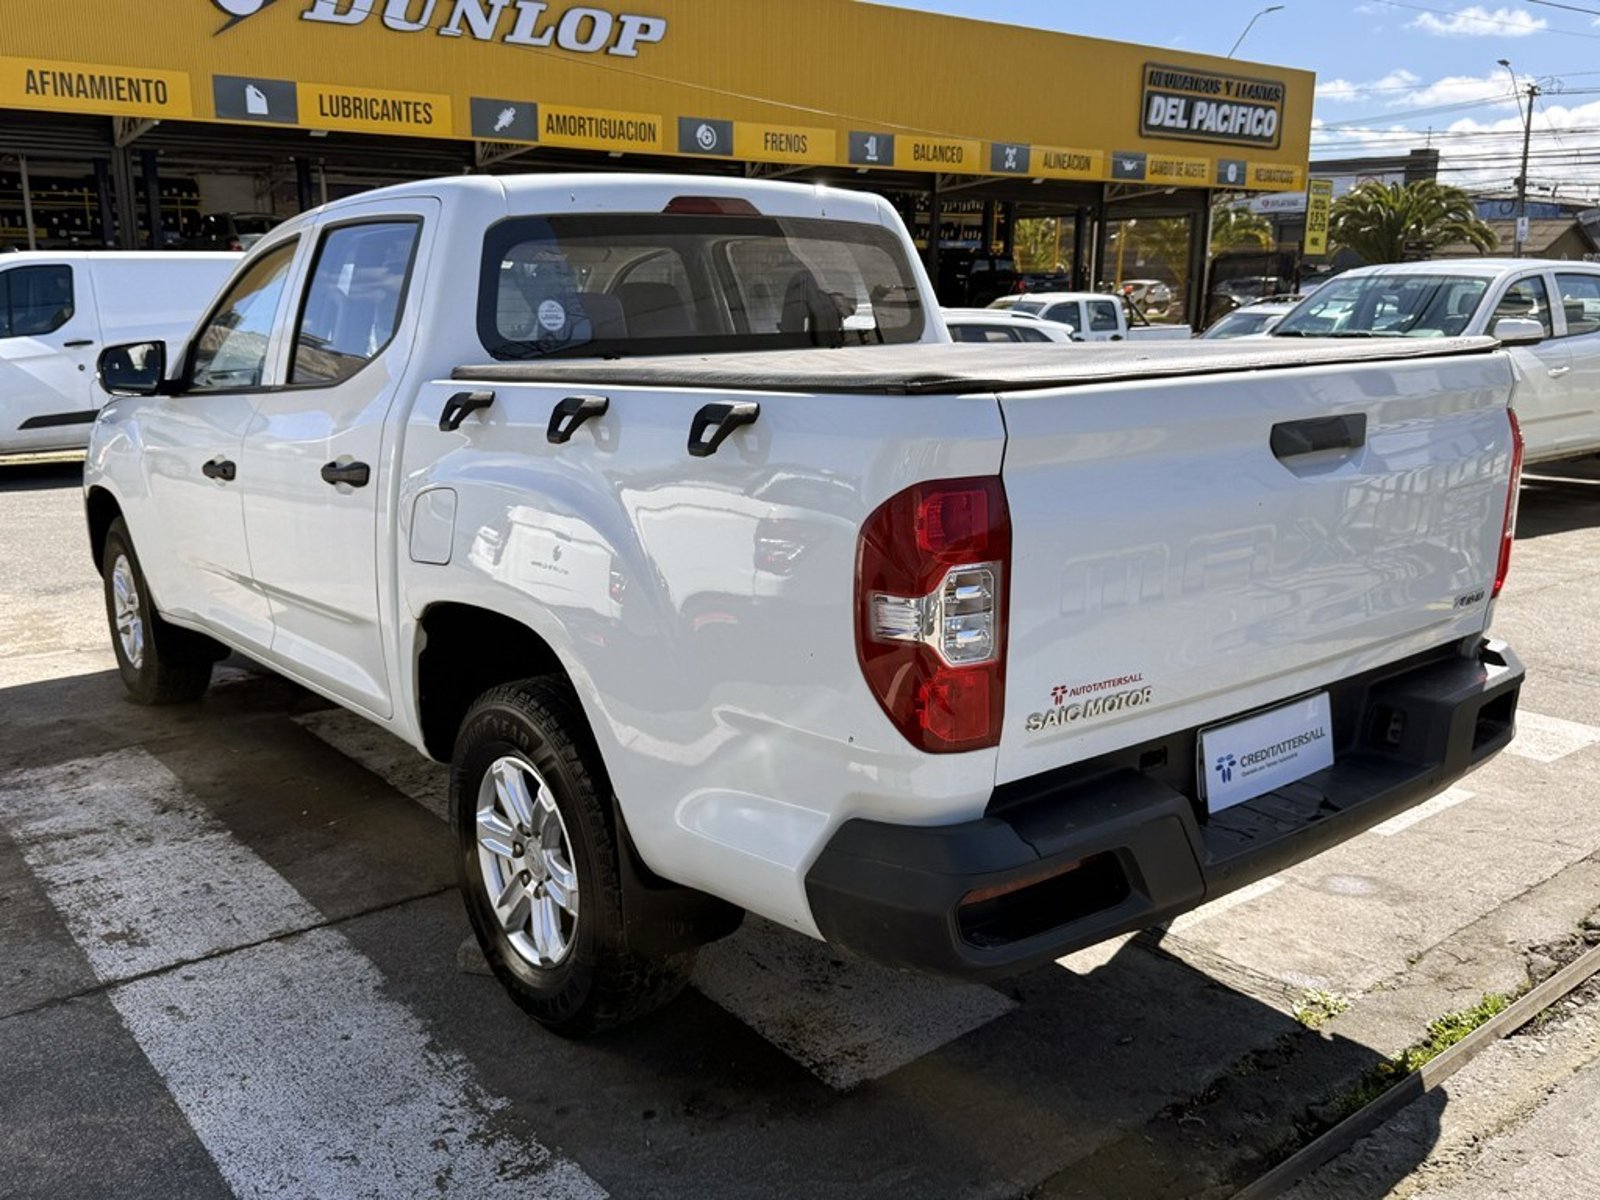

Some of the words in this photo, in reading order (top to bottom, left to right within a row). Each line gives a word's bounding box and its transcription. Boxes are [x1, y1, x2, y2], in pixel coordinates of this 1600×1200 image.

[302, 0, 667, 57] DUNLOP
[25, 69, 168, 105] AFINAMIENTO
[1226, 82, 1235, 96] Y
[318, 93, 434, 126] LUBRICANTES
[1148, 96, 1188, 129] DEL
[1191, 101, 1277, 137] PACIFICO
[545, 112, 657, 144] AMORTIGUACION
[763, 131, 807, 154] FRENOS
[913, 142, 964, 165] BALANCEO
[1043, 152, 1091, 172] ALINEACION
[1069, 673, 1144, 697] AUTOTATTERSALL
[1025, 703, 1082, 732] SAIC
[1082, 685, 1153, 719] MOTOR
[1240, 726, 1326, 768] CREDITATTERSALL
